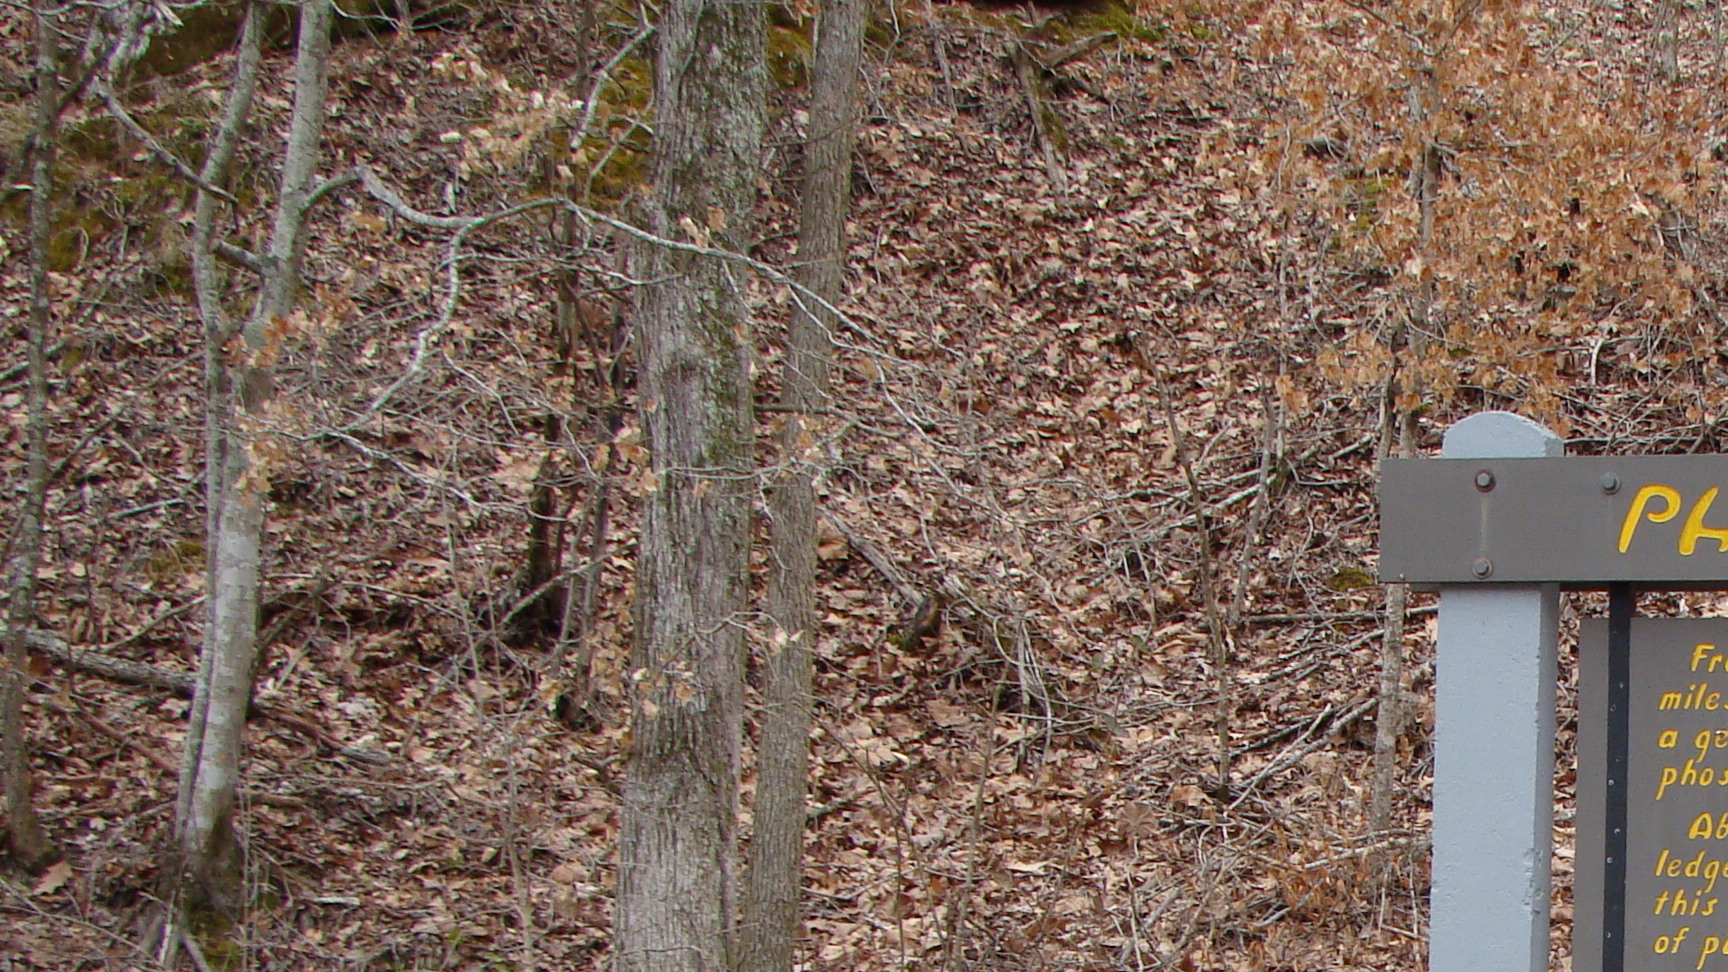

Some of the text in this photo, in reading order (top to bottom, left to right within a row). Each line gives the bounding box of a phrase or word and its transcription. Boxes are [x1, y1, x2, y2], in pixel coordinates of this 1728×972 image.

[1656, 728, 1680, 750] a
[1653, 887, 1720, 917] this
[1652, 924, 1690, 955] of
